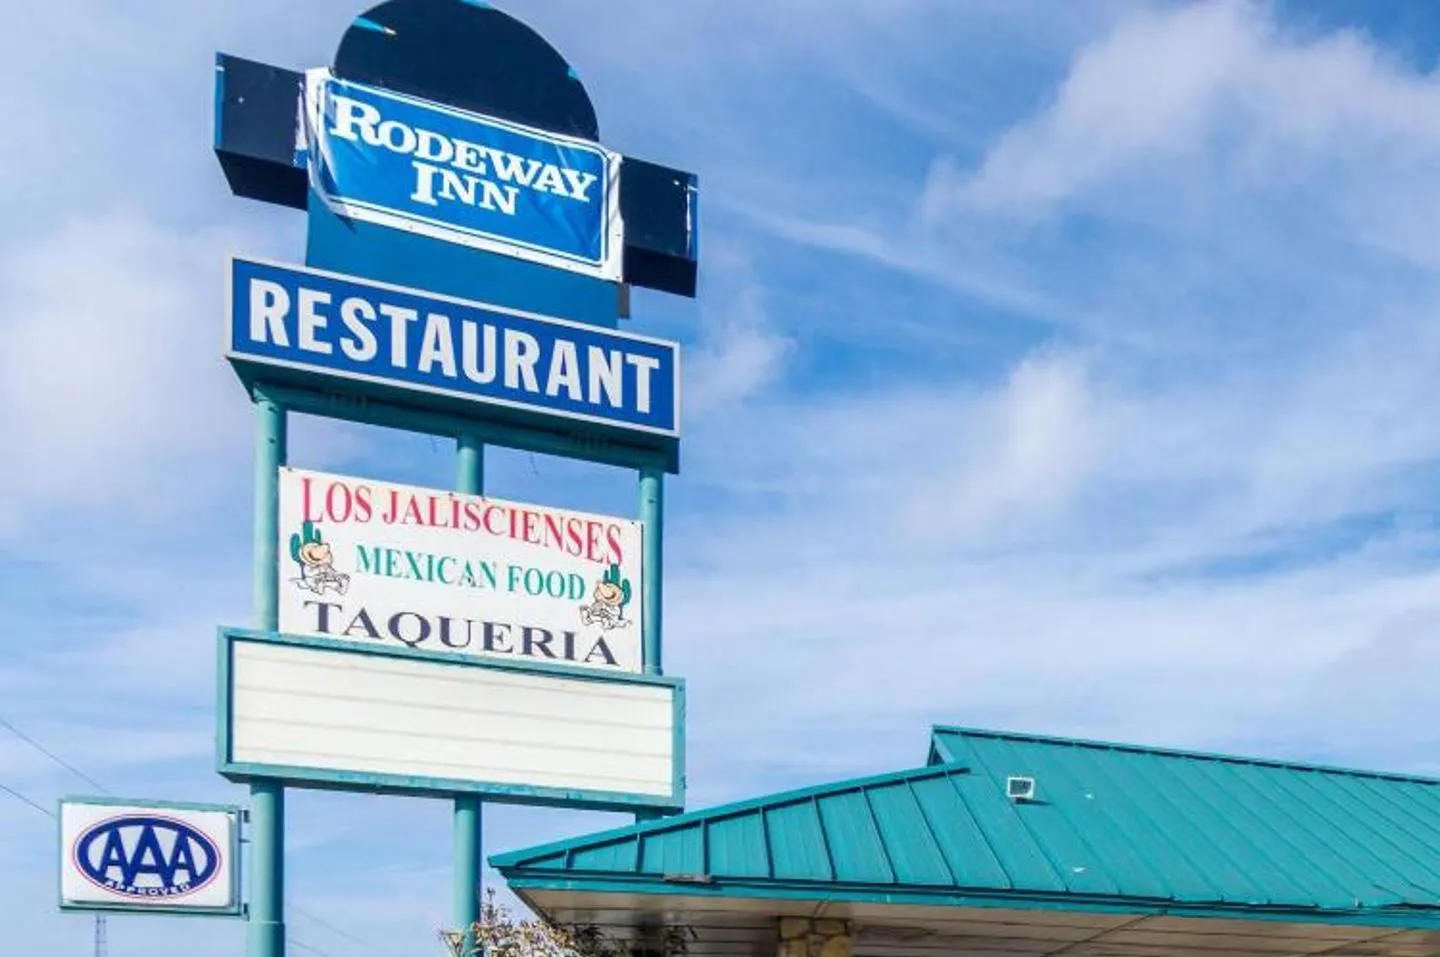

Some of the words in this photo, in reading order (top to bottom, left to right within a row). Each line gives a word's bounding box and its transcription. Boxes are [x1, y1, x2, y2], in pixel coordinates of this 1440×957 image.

[329, 95, 597, 202] RODEWAY
[411, 161, 518, 216] INN
[248, 277, 660, 414] RESTAURANT
[300, 477, 373, 524] LOS
[382, 491, 624, 566] JALISCIENSES
[355, 543, 498, 592] MEXICAN
[506, 565, 587, 601] FOOD
[303, 600, 619, 665] TAQUERIA
[98, 824, 202, 886] AAA
[103, 878, 192, 897] APPROVED
